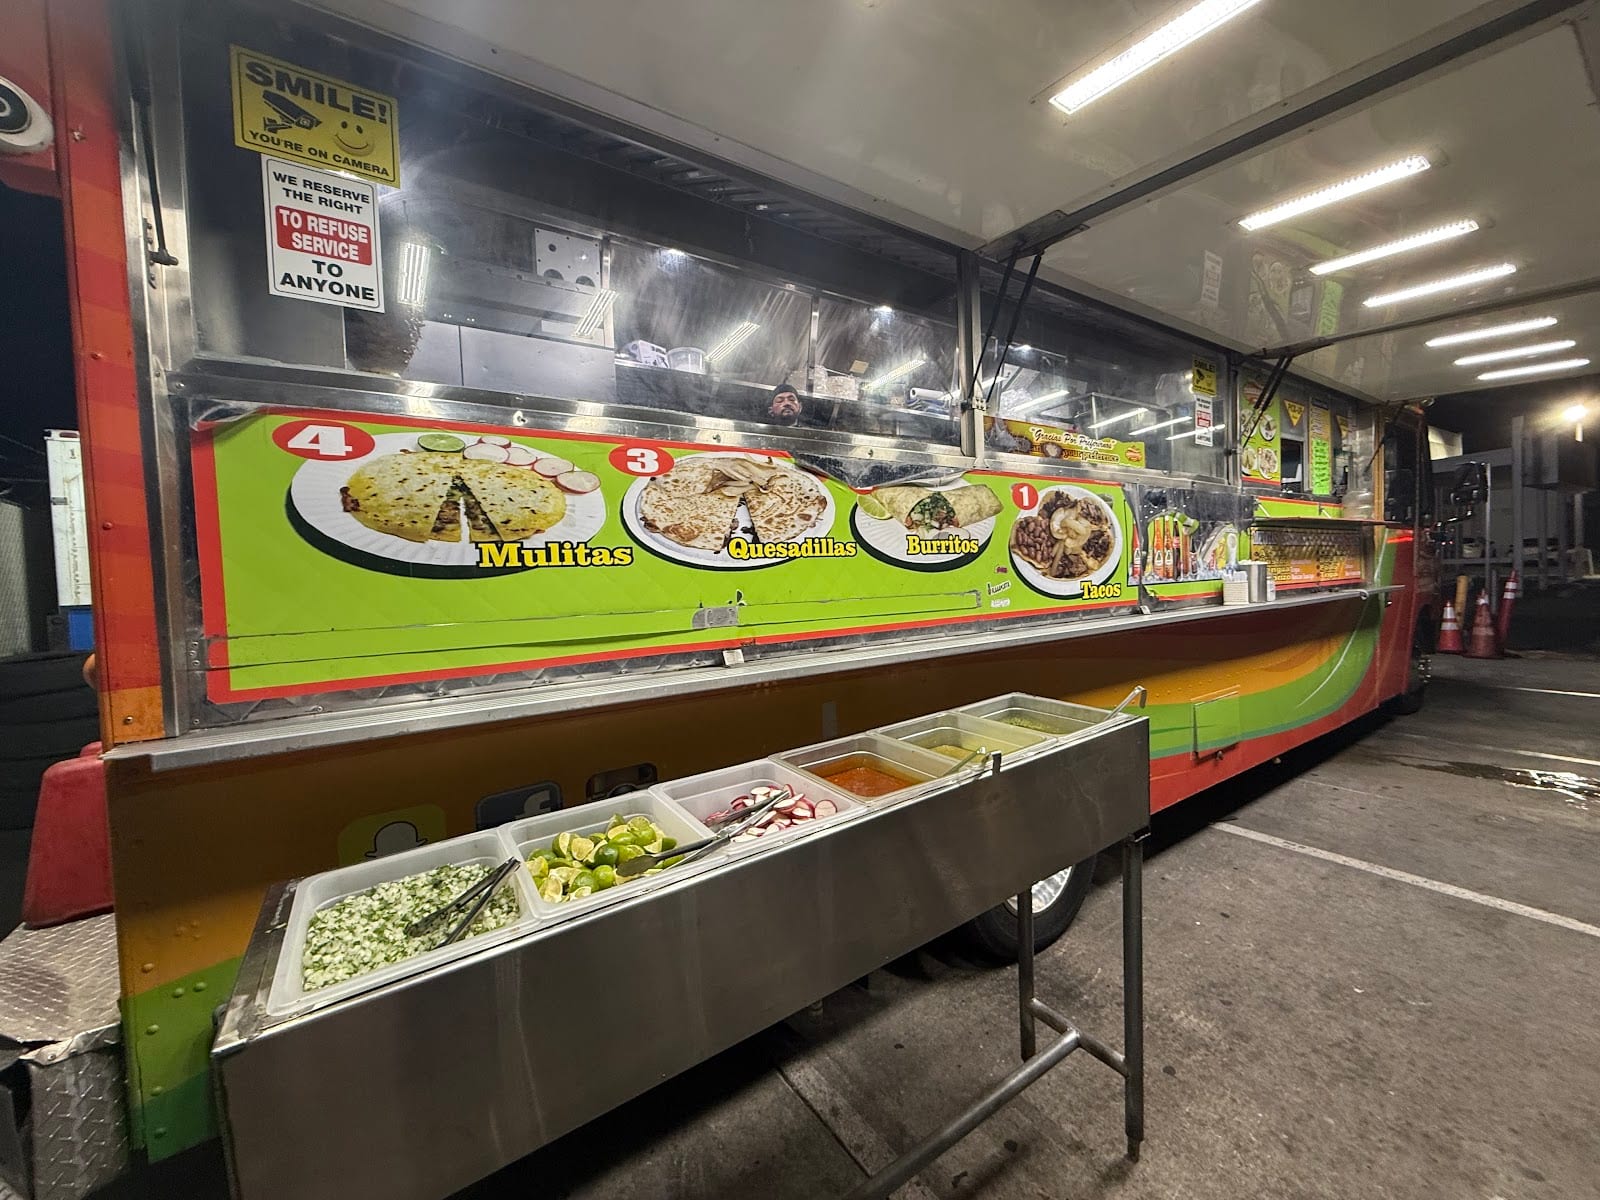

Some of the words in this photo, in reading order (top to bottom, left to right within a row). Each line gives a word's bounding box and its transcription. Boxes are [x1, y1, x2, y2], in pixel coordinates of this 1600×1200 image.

[245, 61, 387, 125] SMILE!
[249, 130, 303, 153] YOU'RE
[308, 146, 328, 160] ON
[333, 153, 389, 177] CAMERA
[273, 171, 297, 186] WE
[303, 179, 370, 204] RESERVE
[282, 187, 313, 203] THE
[319, 195, 363, 215] RIGHT
[279, 208, 302, 229] TO
[307, 217, 368, 244] REFUSE
[291, 232, 359, 262] SERVICE
[311, 259, 343, 278] TO
[279, 272, 375, 301] ANYONE
[287, 424, 353, 457] 4
[1064, 433, 1077, 444] Por
[626, 447, 660, 473] 3
[1018, 486, 1030, 507] 1
[475, 541, 634, 570] Mulitas
[727, 537, 857, 560] Quesadillas
[906, 535, 980, 556] Burritos
[1080, 581, 1121, 600] Tacos
